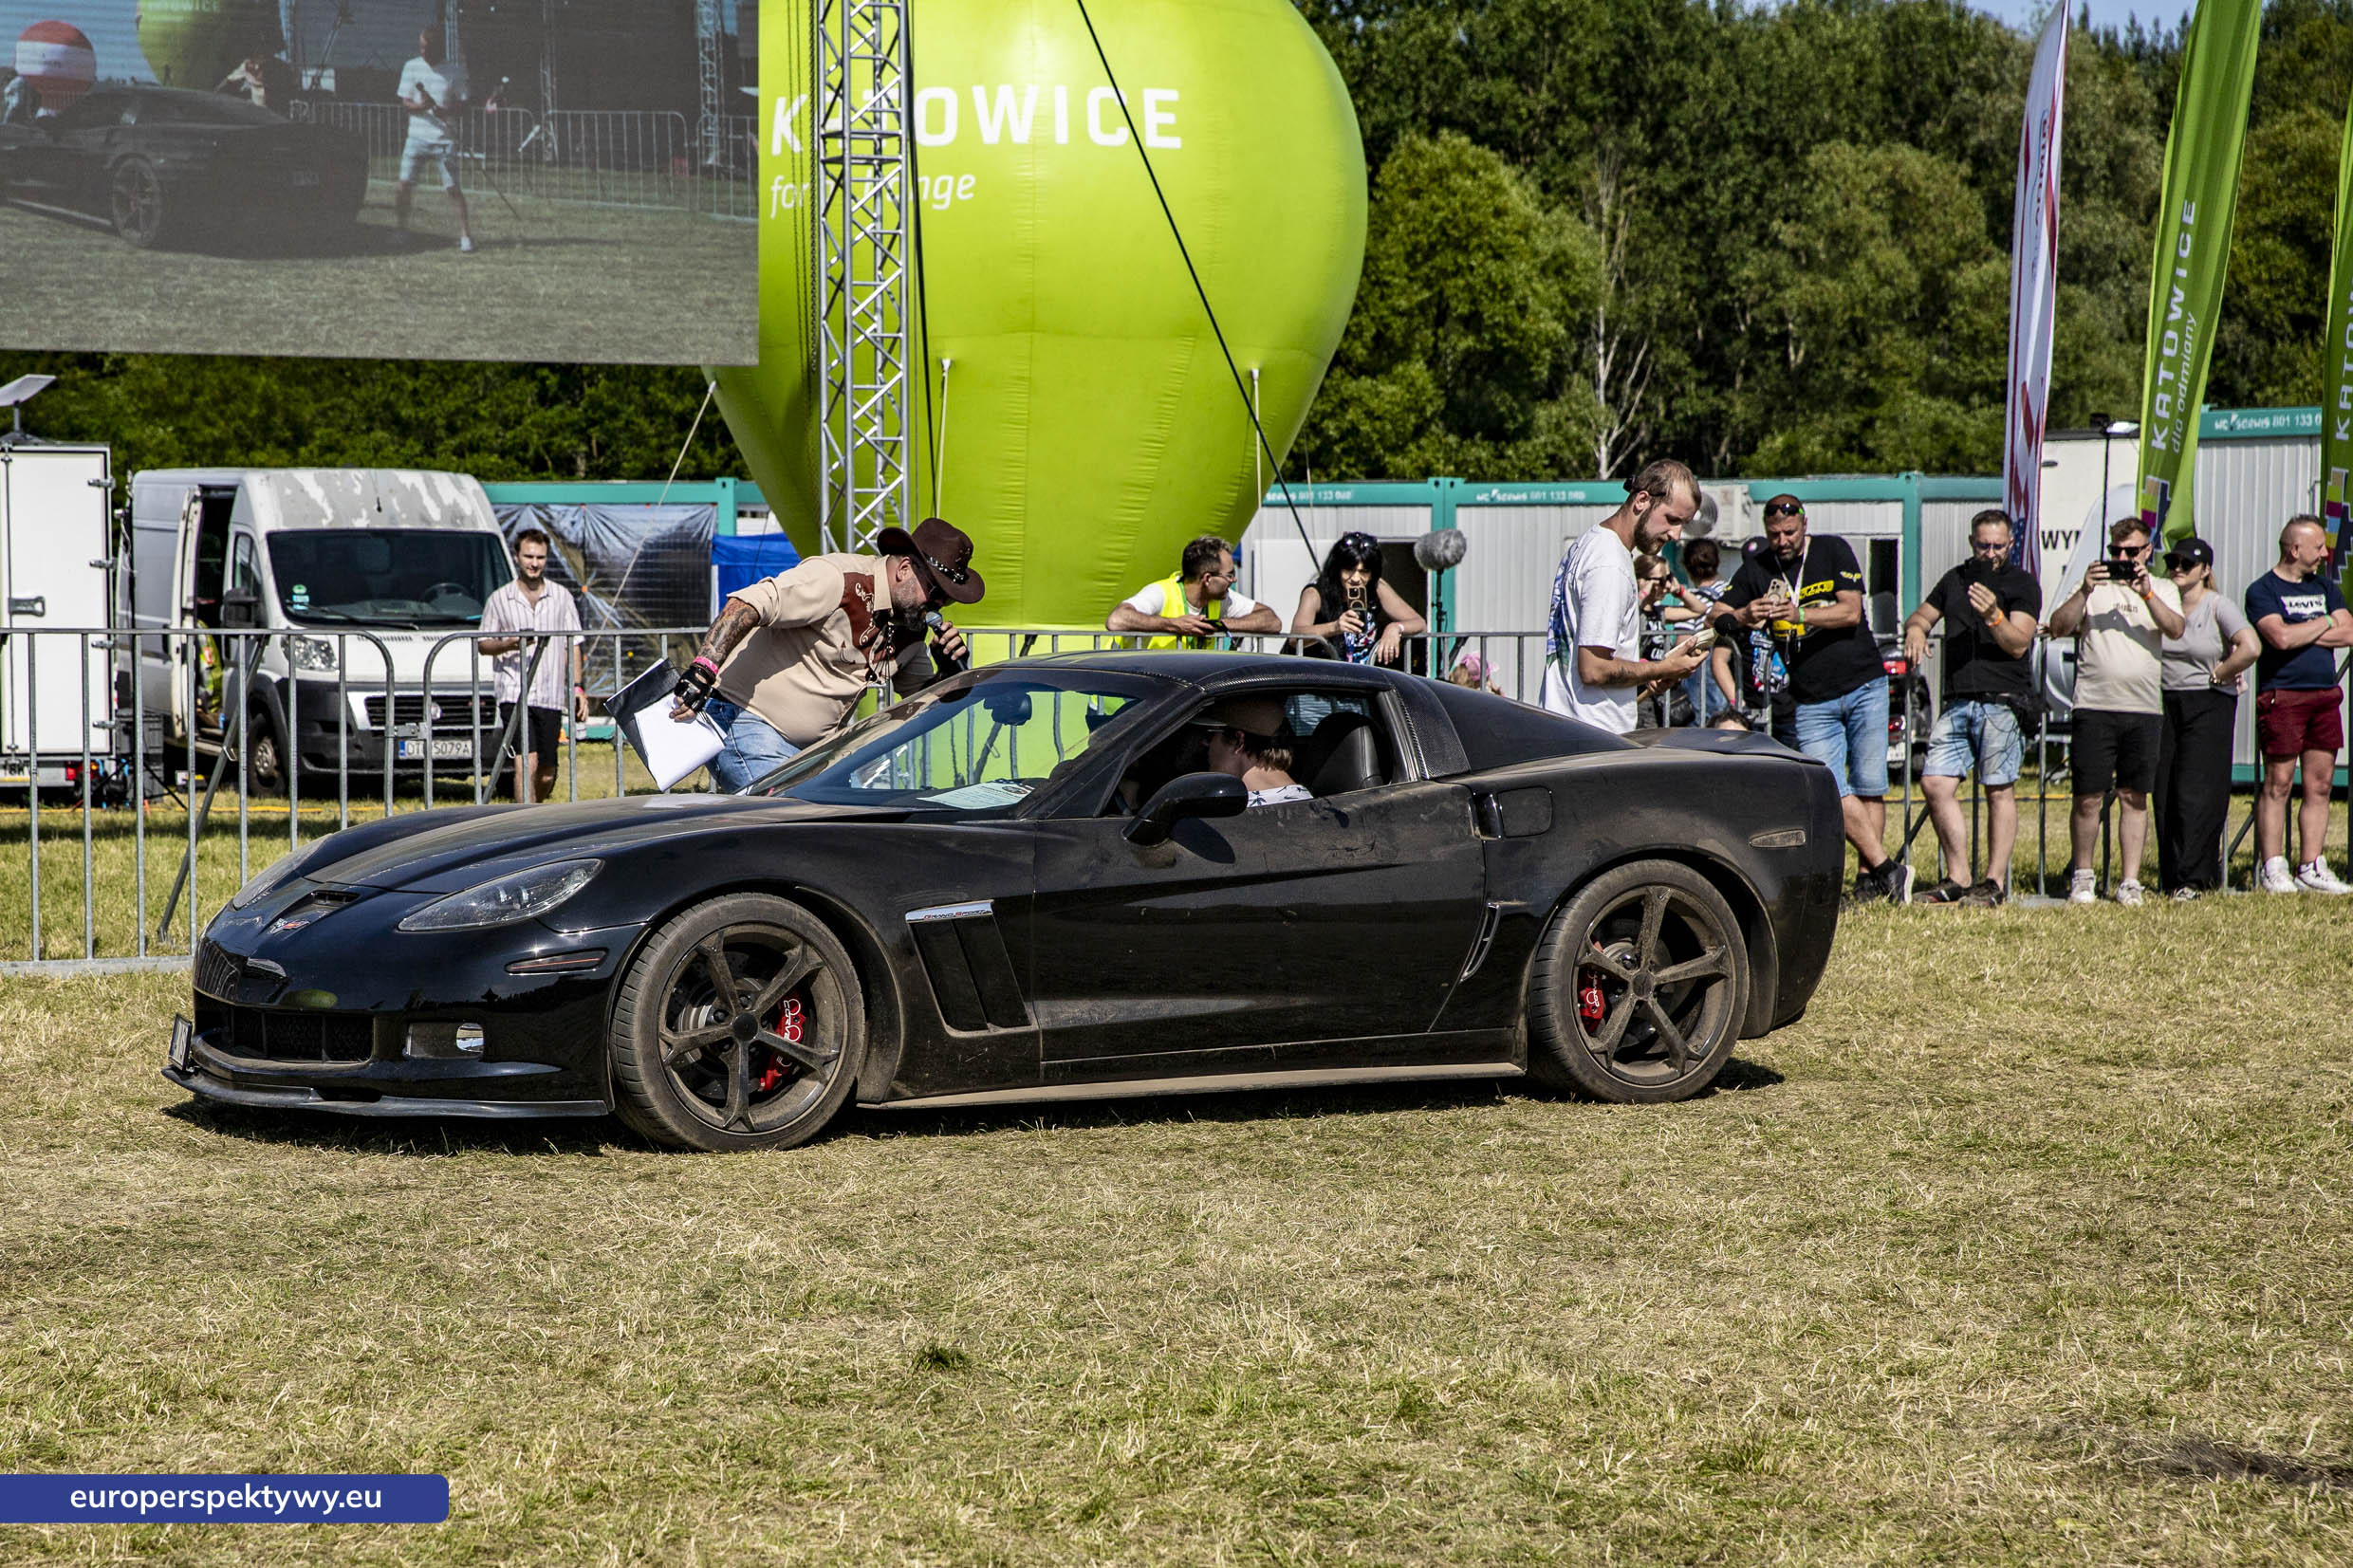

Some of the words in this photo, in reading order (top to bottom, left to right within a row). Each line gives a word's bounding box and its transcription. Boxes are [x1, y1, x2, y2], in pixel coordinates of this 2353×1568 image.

[770, 175, 810, 220] for
[2151, 199, 2196, 451] KATOWICE
[2176, 311, 2197, 414] odmiany
[2335, 278, 2353, 441] KATO
[2296, 412, 2312, 427] 133
